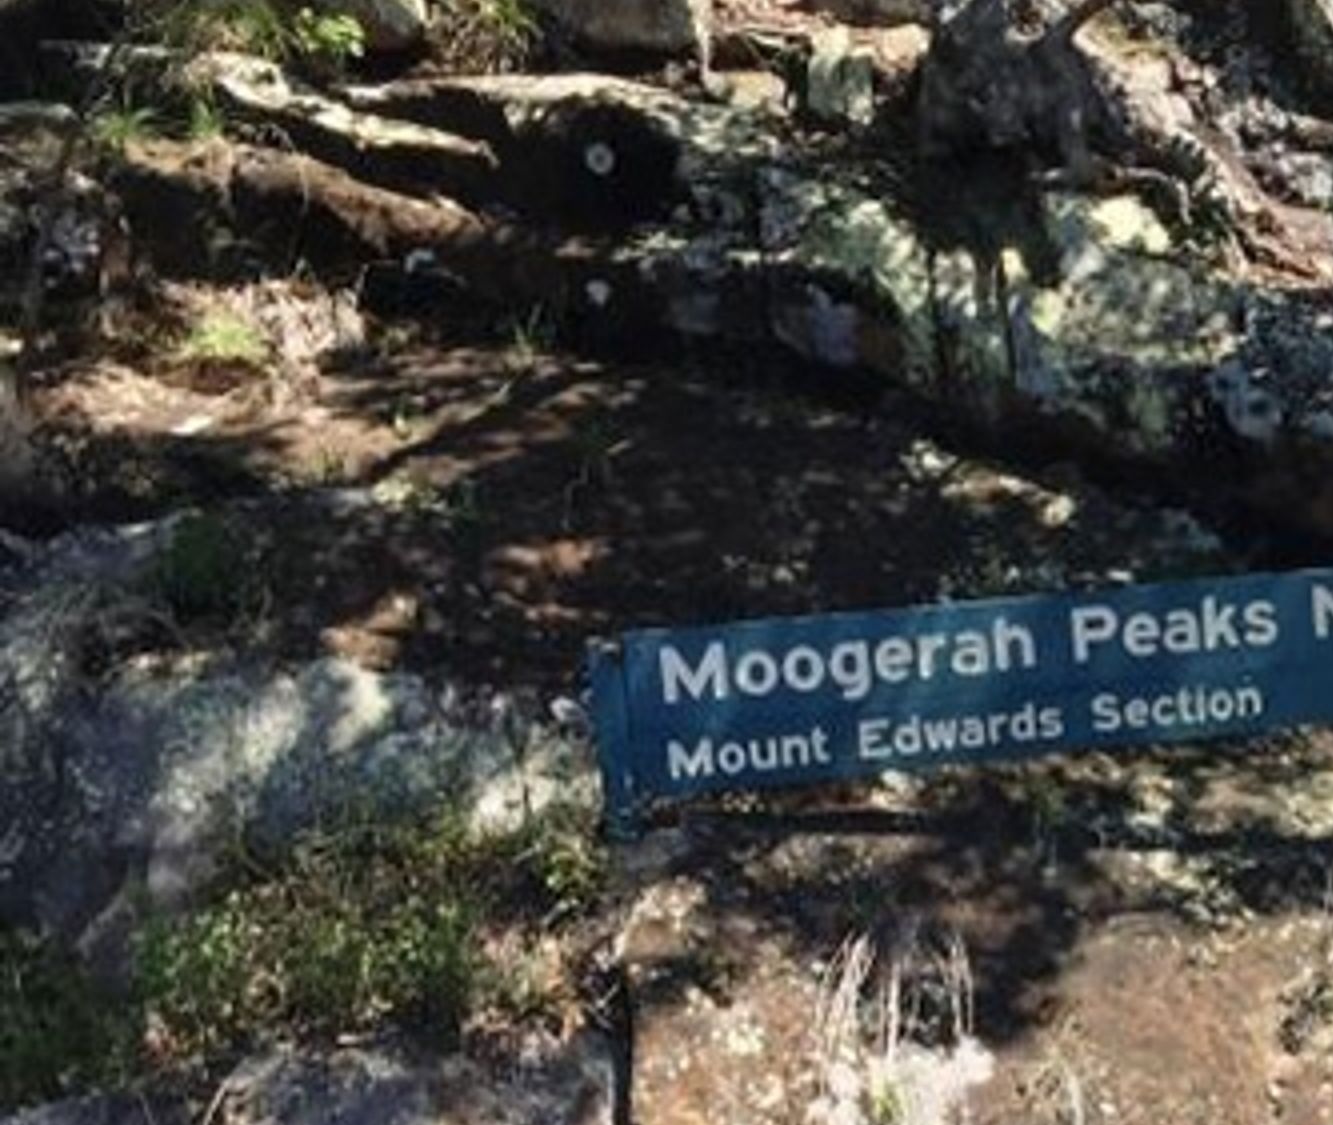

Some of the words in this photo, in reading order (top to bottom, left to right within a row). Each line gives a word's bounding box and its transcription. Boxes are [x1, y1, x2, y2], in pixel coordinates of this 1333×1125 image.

[659, 617, 1036, 704] Moogerah
[1071, 595, 1278, 663] Peaks
[667, 725, 829, 780] Mount
[858, 704, 1063, 760] Edwards
[1091, 679, 1262, 731] Section
